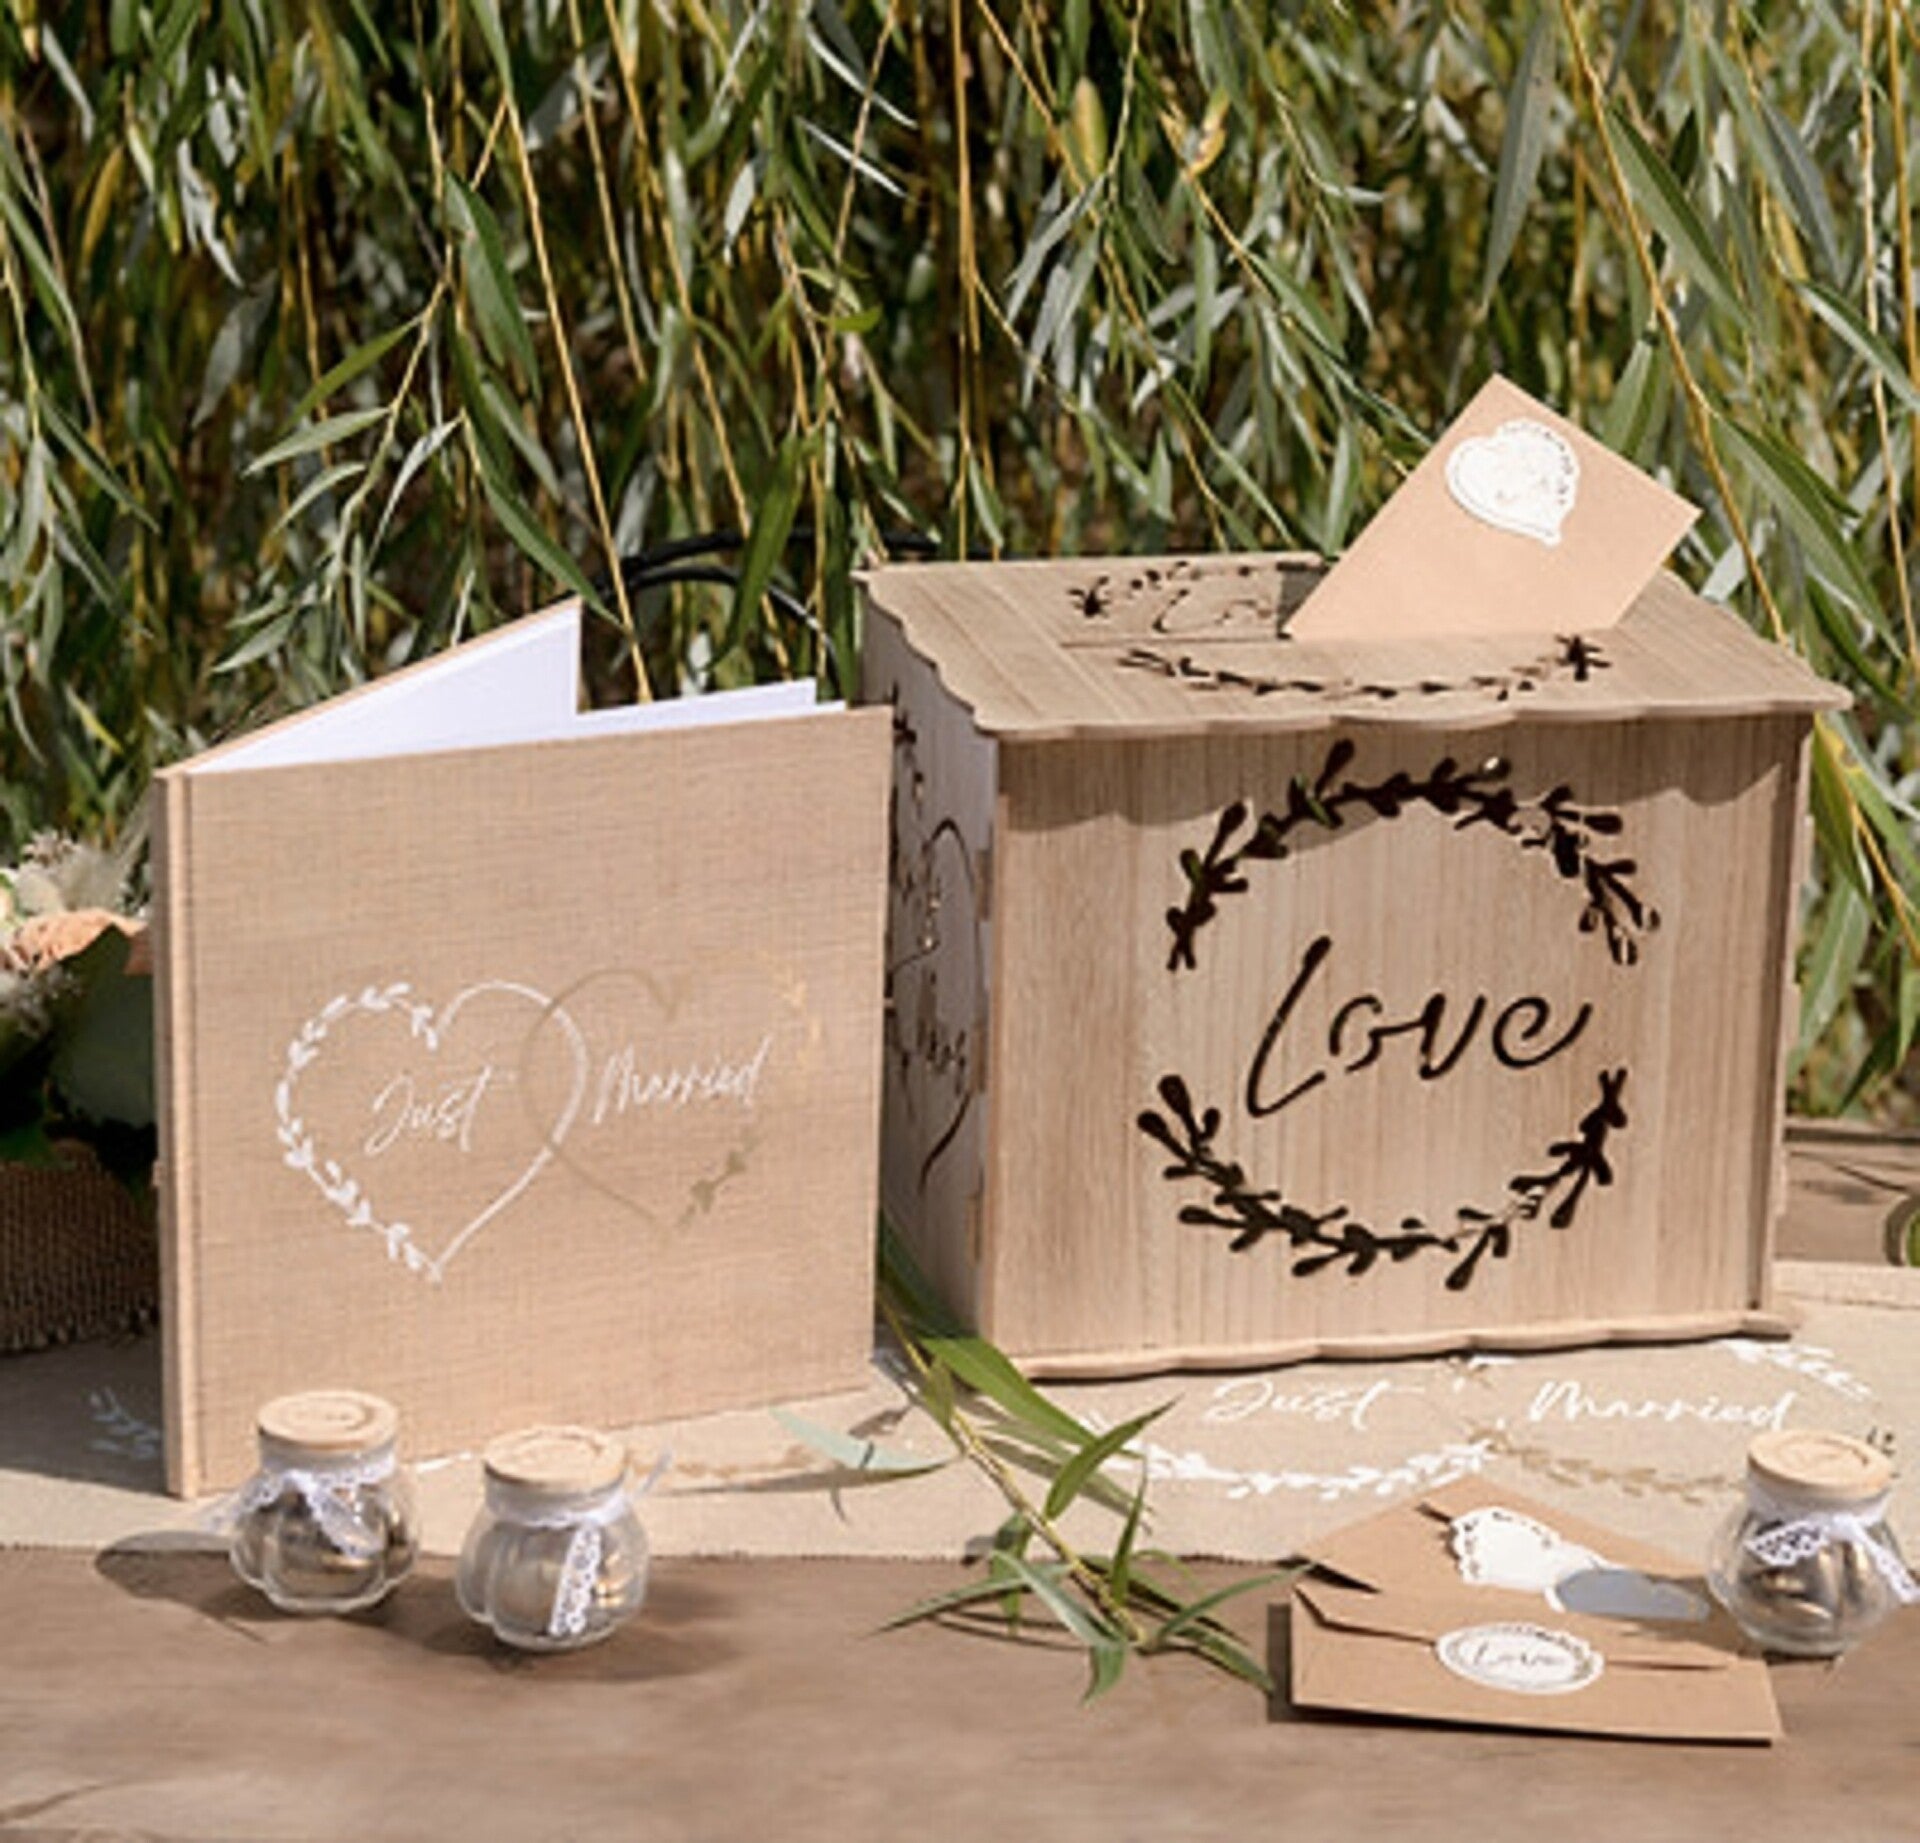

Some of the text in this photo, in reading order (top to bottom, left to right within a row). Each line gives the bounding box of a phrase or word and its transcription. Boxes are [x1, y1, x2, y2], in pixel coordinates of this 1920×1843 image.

[1246, 935, 1593, 1118] Love
[364, 1064, 502, 1157] Just
[593, 1033, 774, 1125] Married
[1202, 1376, 1798, 1432] Just Married
